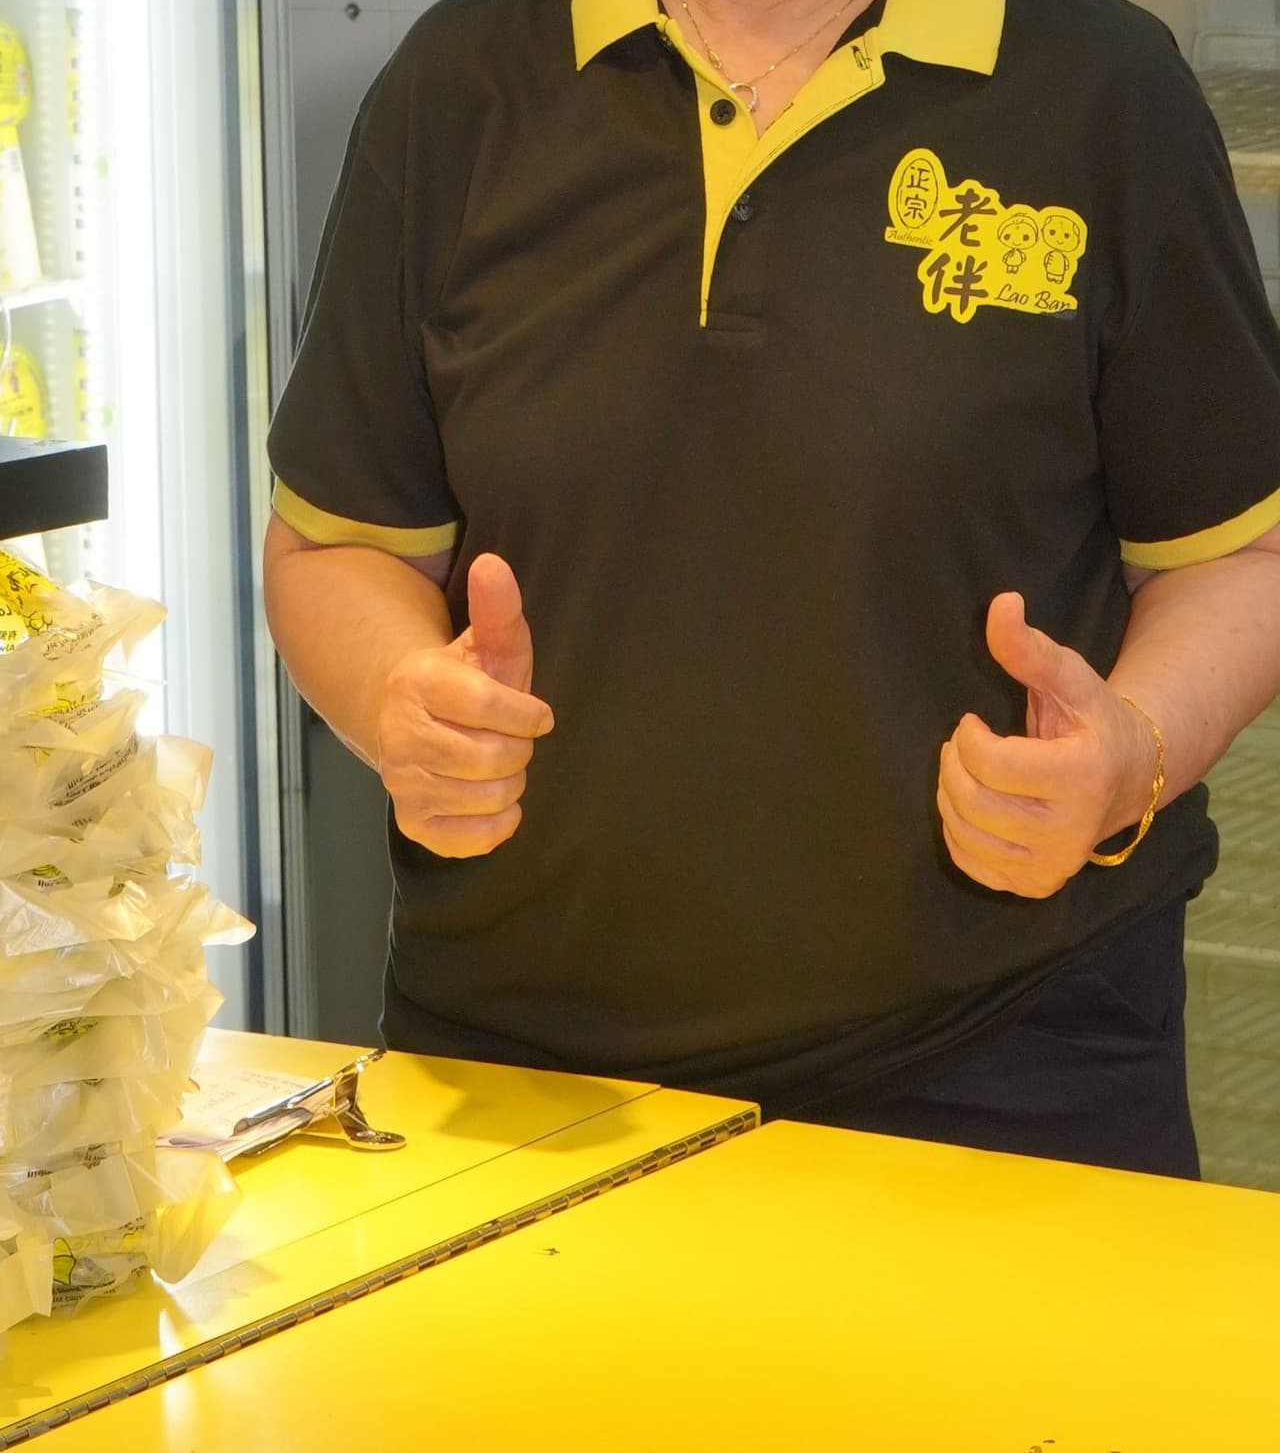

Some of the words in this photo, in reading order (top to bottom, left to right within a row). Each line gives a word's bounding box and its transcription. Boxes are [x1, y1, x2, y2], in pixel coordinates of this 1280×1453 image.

[904, 166, 930, 220] 正宗
[887, 229, 934, 245] Authentic
[926, 188, 997, 315] 老伴
[994, 283, 1029, 305] Lao
